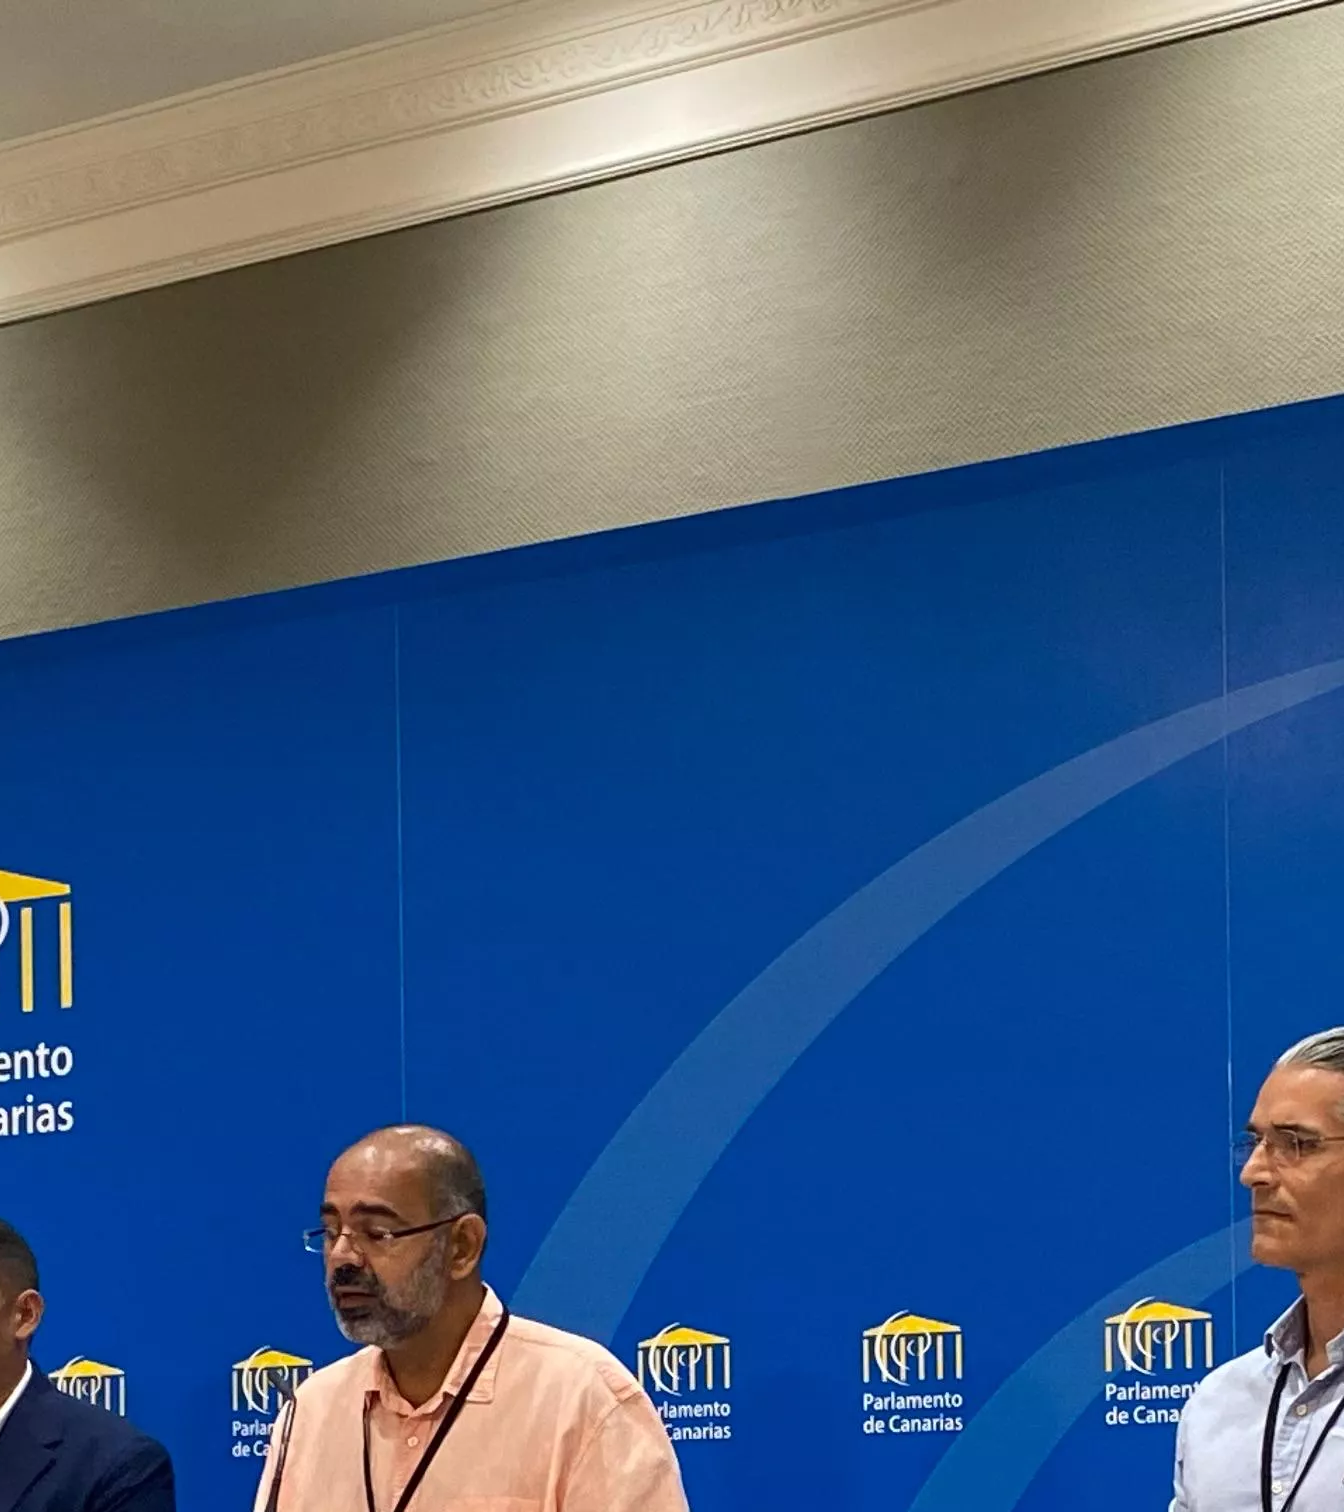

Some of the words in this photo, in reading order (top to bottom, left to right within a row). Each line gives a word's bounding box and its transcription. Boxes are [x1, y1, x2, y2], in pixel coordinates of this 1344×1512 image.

[657, 1400, 731, 1419] rlamento
[862, 1391, 963, 1411] Parlamento
[862, 1415, 886, 1434] de
[888, 1413, 964, 1433] Canarias
[1105, 1406, 1129, 1425] de
[1133, 1405, 1181, 1424] Cana
[232, 1419, 273, 1437] Parla
[232, 1441, 251, 1457] de
